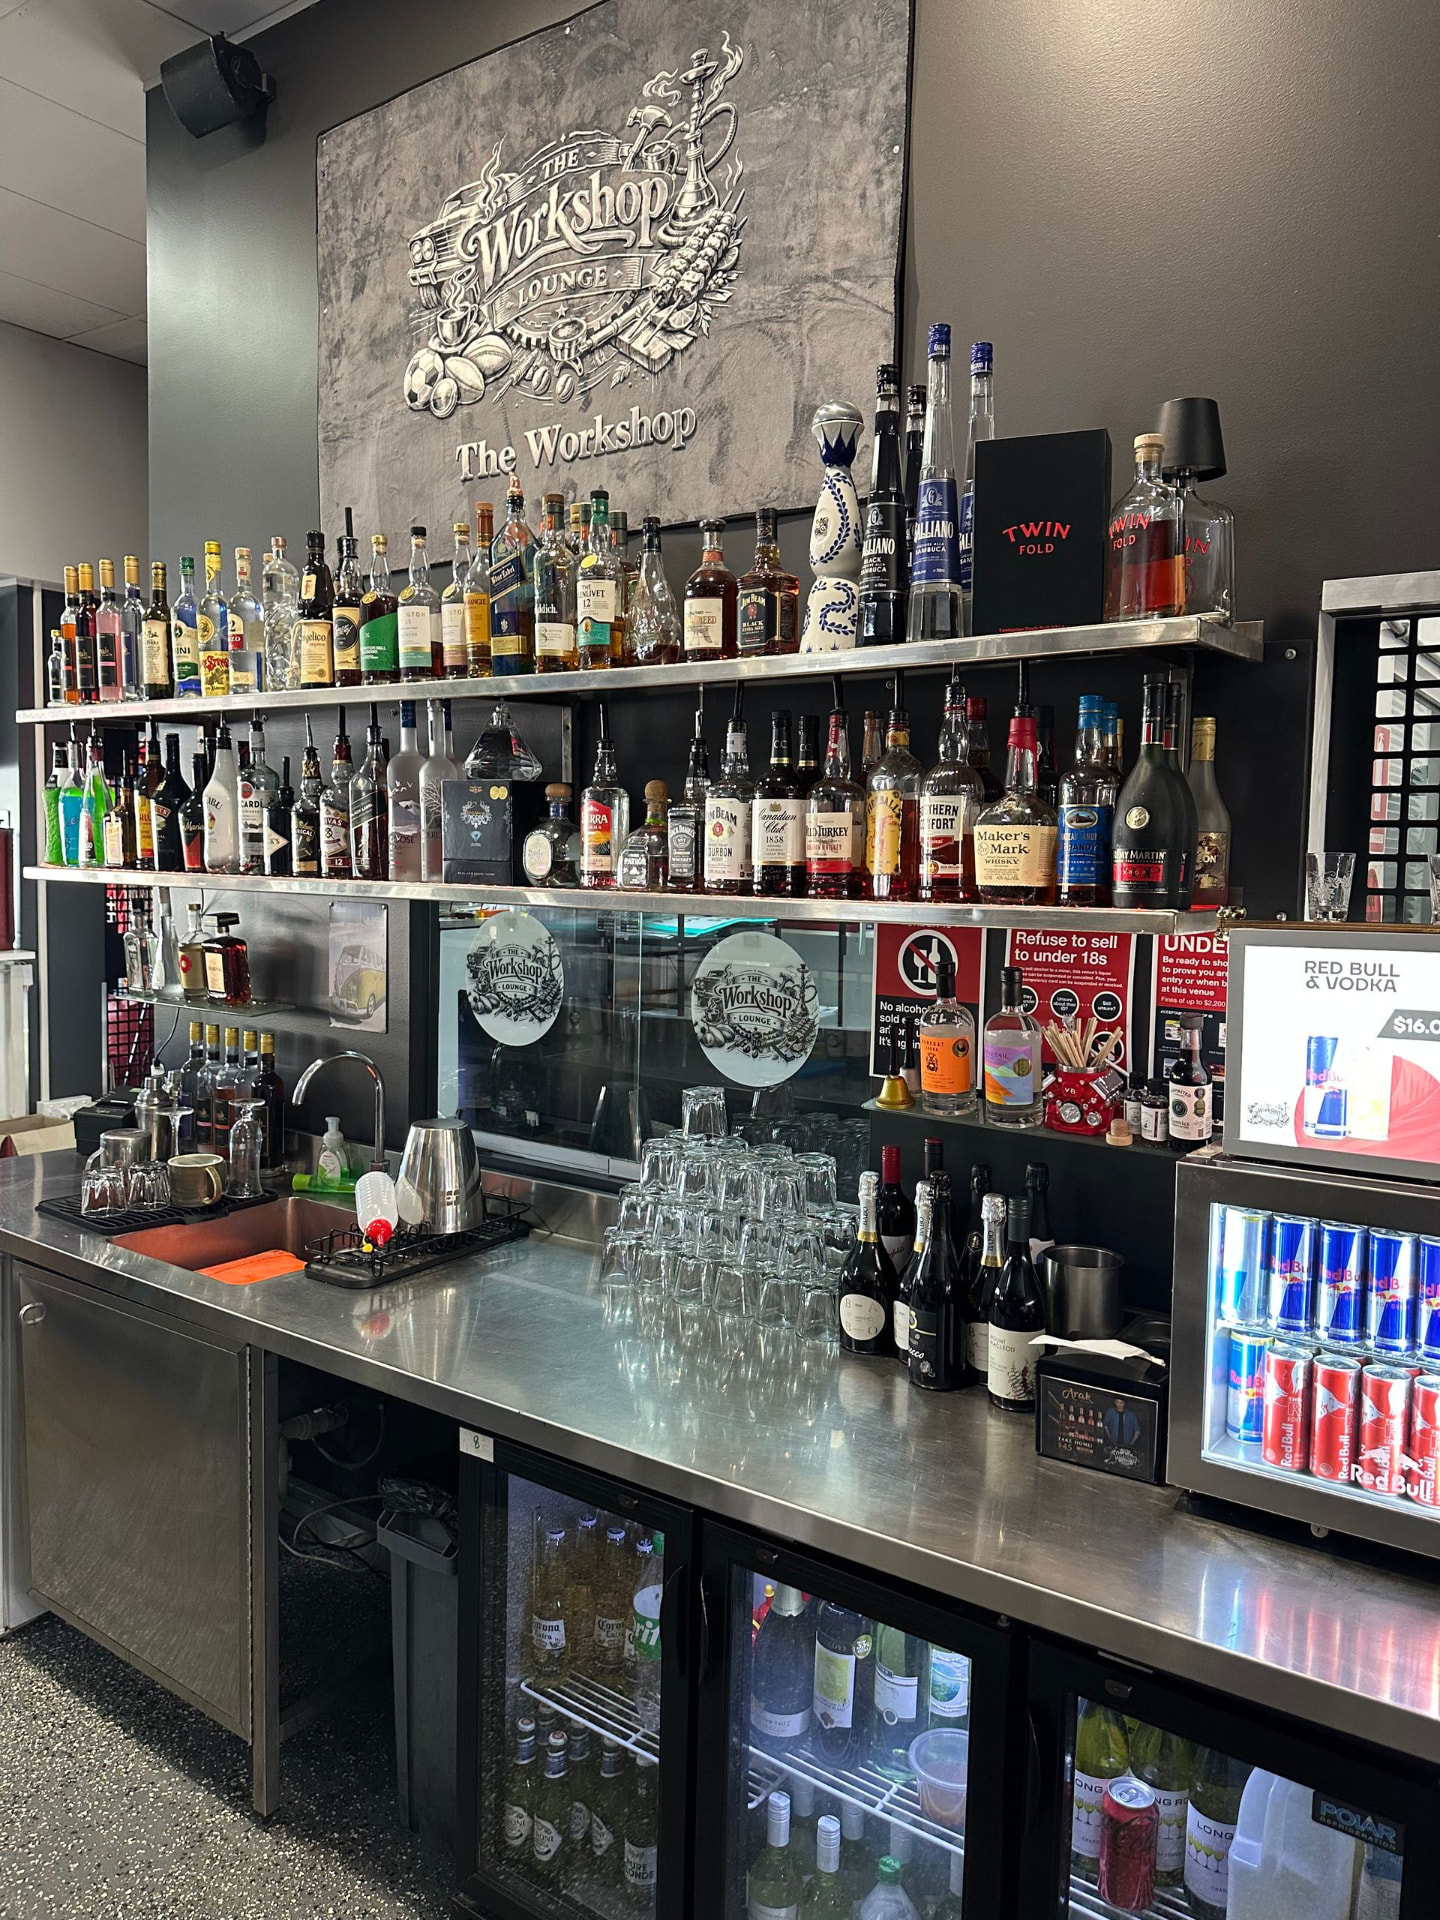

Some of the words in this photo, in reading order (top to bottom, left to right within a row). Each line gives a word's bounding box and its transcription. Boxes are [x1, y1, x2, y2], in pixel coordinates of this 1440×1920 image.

[541, 149, 579, 180] THE
[457, 170, 674, 293] Workshop
[517, 265, 609, 307] LOUNGE
[456, 441, 517, 482] The
[525, 405, 697, 468] Workshop
[1002, 520, 1071, 544] TWIN
[1108, 513, 1151, 539] TWIN
[1019, 543, 1055, 556] FOLD
[1112, 534, 1136, 550] FOLD
[583, 599, 591, 608] 12
[750, 593, 766, 607] BEAM
[742, 620, 764, 628] BLACK
[715, 806, 738, 827] BEAM
[759, 807, 798, 821] Canadian
[763, 820, 788, 834] Club
[817, 825, 849, 838] TURKEY
[765, 836, 784, 844] 1858
[977, 831, 1031, 841] Maker's
[990, 843, 1029, 854] Mark
[1130, 848, 1167, 860] MARTIN
[335, 858, 343, 866] 12
[1015, 931, 1068, 947] Refuse
[1071, 934, 1087, 948] to
[1091, 935, 1118, 949] sell
[1014, 948, 1029, 961] to
[1033, 949, 1077, 963] under
[1081, 951, 1108, 965] 18s
[1162, 955, 1174, 964] Be
[1175, 956, 1200, 967] ready
[1201, 958, 1211, 966] to
[483, 957, 543, 985] Workshop
[1172, 967, 1197, 975] prove
[1198, 969, 1215, 977] you
[1304, 960, 1343, 975] RED
[1350, 962, 1401, 978] BULL
[747, 974, 762, 983] THE
[1161, 975, 1183, 985] entry
[1184, 977, 1195, 985] or
[1196, 978, 1220, 987] when
[1305, 975, 1320, 990] &
[1325, 976, 1397, 993] VODKA
[502, 984, 528, 992] LOUNGE
[1161, 985, 1170, 993] at
[1171, 986, 1188, 995] this
[1189, 987, 1215, 996] venue
[714, 984, 792, 1019] Workshop
[880, 1000, 893, 1011] No
[1161, 995, 1178, 1004] Fines
[738, 1013, 772, 1026] LOUNGE
[879, 1013, 899, 1023] sold
[1061, 1387, 1094, 1404] Arak
[1281, 1422, 1294, 1444] Bull
[473, 1434, 481, 1450] 8
[1338, 1434, 1351, 1456] Bull
[1280, 1444, 1294, 1467] Red
[1337, 1457, 1350, 1479] Red
[1350, 1463, 1389, 1491] Red
[1391, 1473, 1433, 1503] Bull
[1196, 1818, 1235, 1841] LONG
[1320, 1800, 1397, 1845] POLAR
[1320, 1816, 1396, 1851] REFRIGERATION
